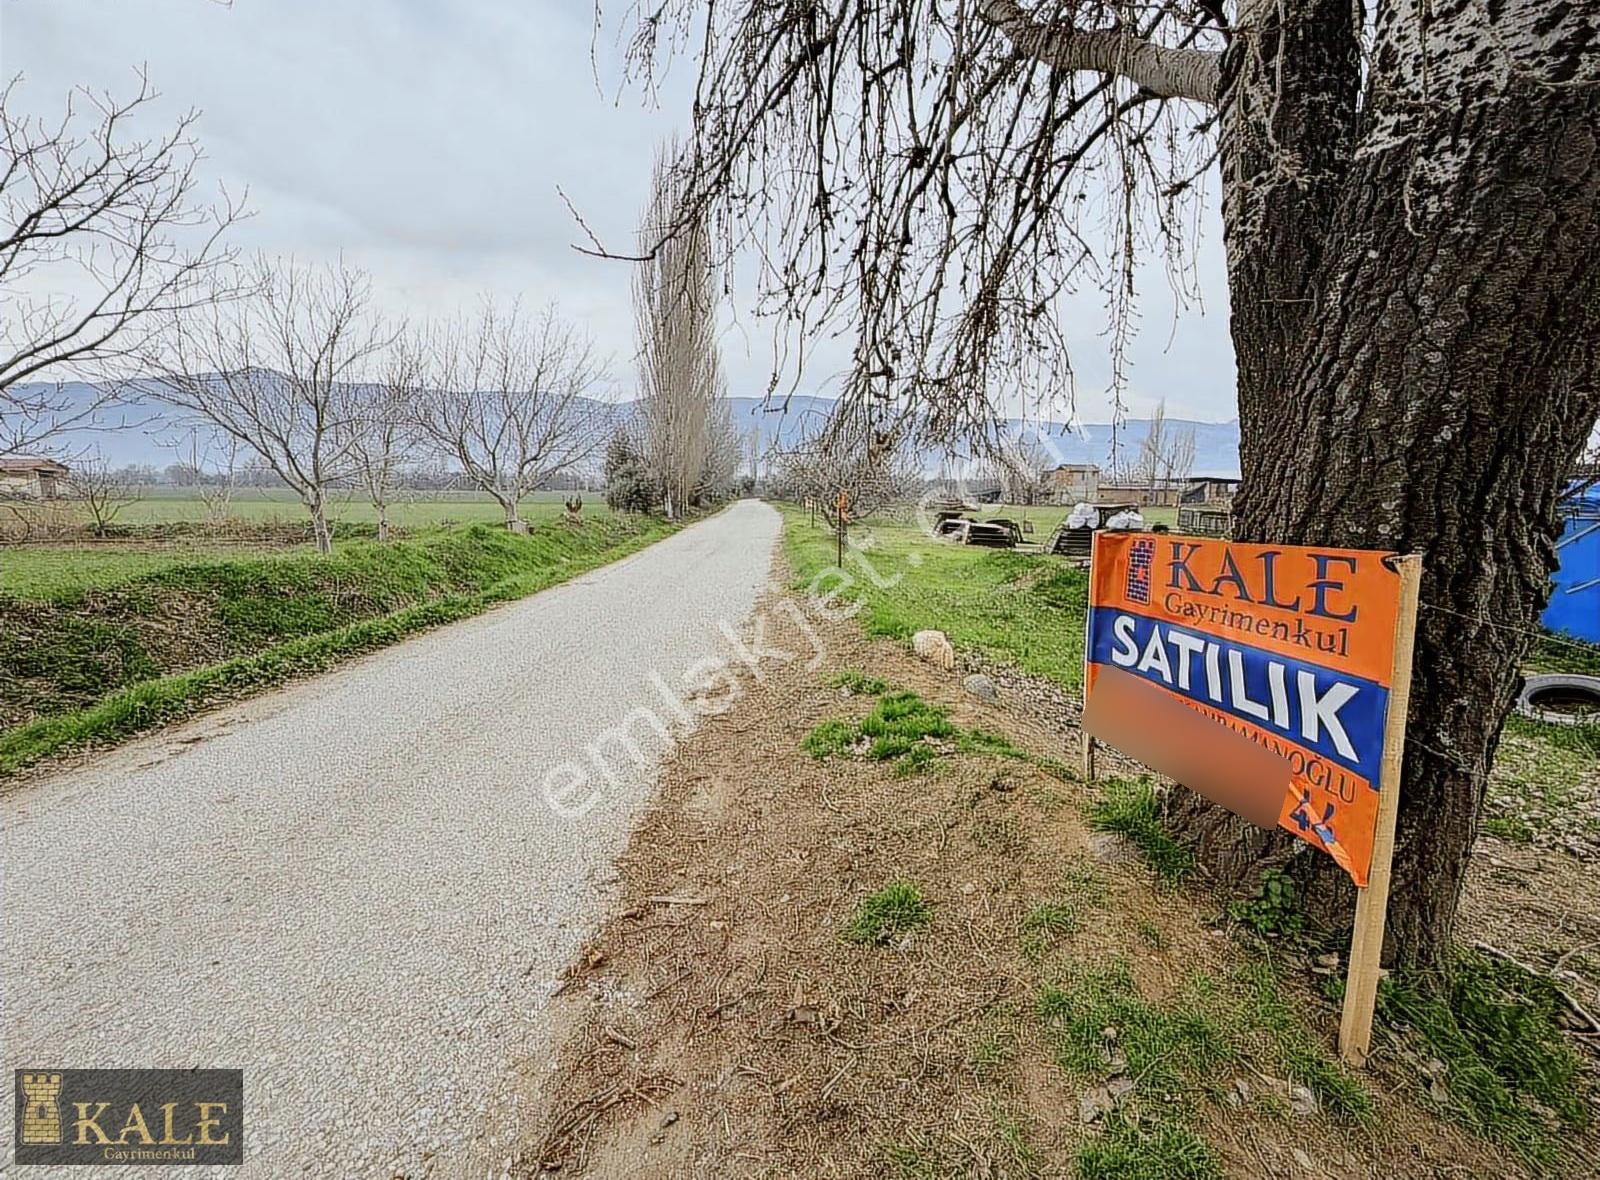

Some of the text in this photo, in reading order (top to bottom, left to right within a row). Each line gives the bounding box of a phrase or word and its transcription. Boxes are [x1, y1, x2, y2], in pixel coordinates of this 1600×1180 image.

[1165, 541, 1358, 623] KALE
[1165, 592, 1349, 657] Gayrimenkul
[1111, 615, 1360, 763] SATILIK
